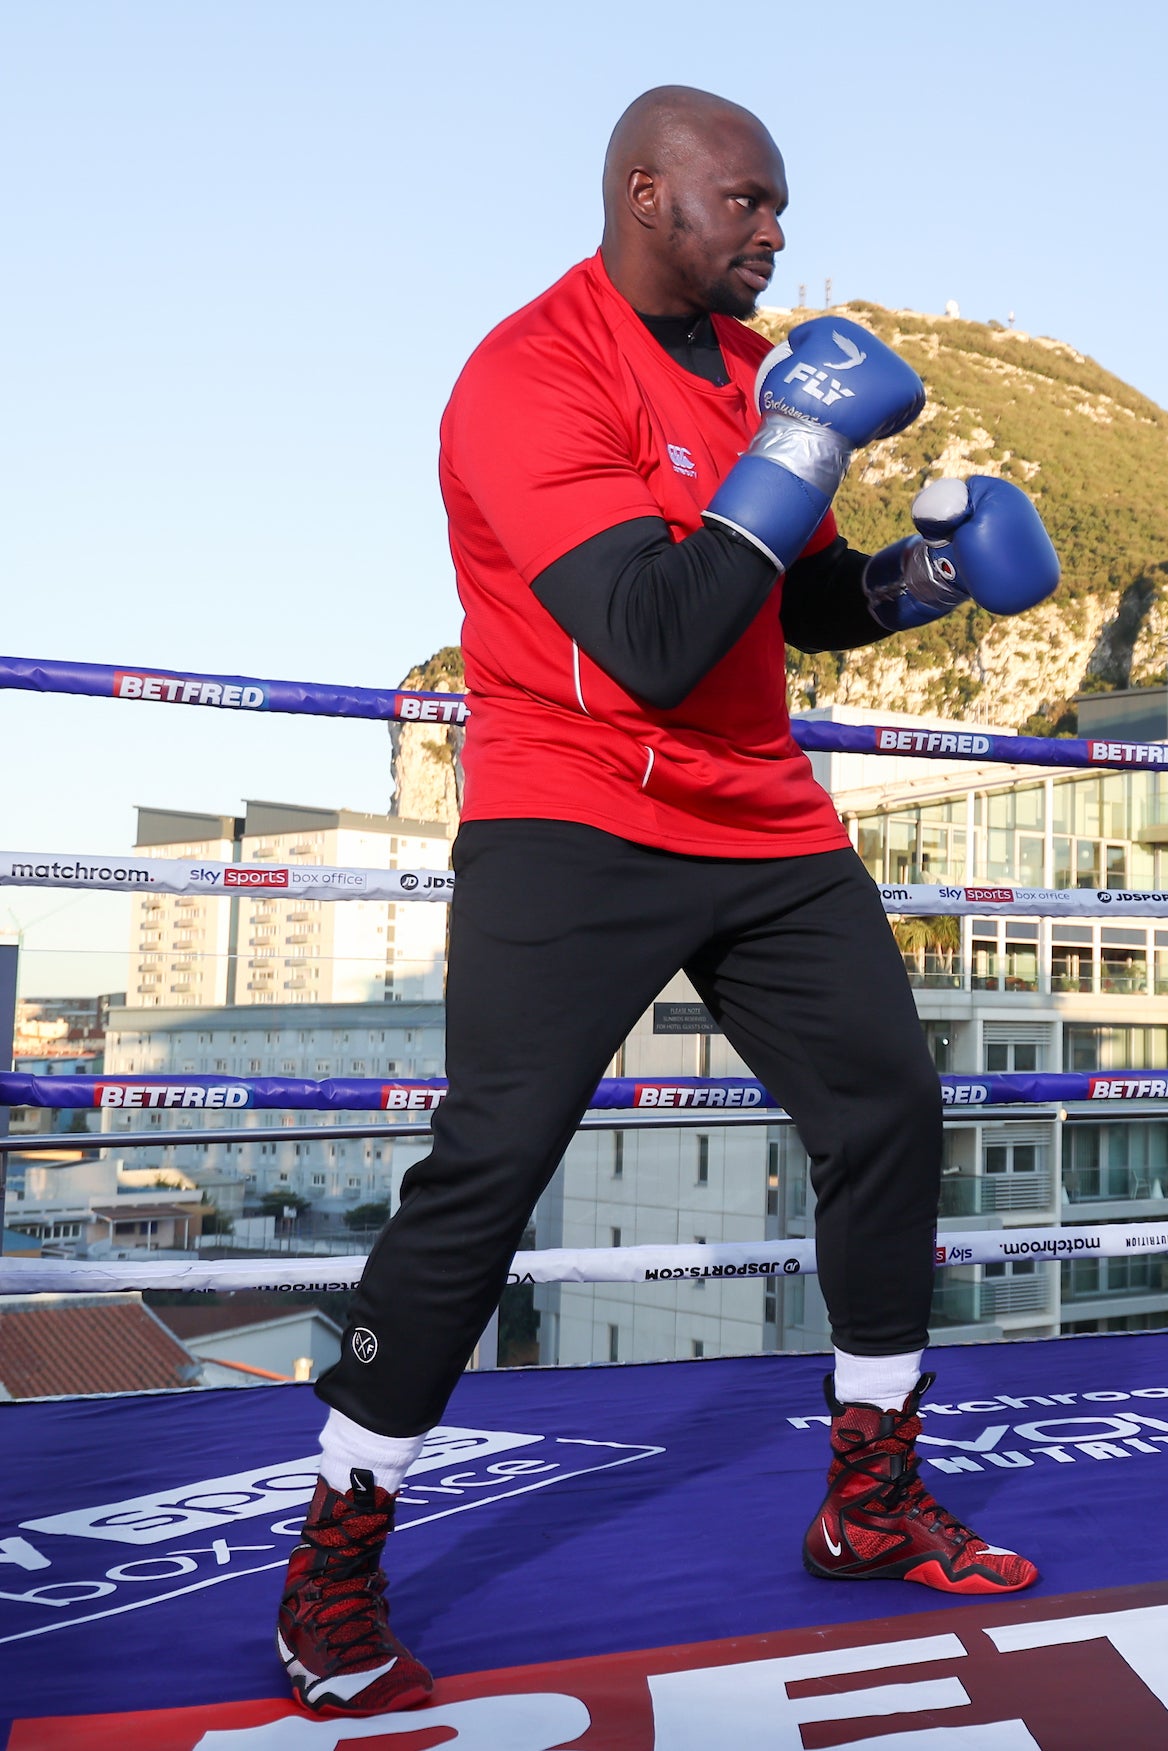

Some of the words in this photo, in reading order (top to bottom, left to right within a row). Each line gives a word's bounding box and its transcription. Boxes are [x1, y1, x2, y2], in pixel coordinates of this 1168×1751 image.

[783, 362, 856, 406] FLY
[118, 676, 265, 709] BETFRED
[400, 698, 472, 722] BETF
[879, 730, 990, 755] BETFRED
[11, 861, 155, 883] matchroom.
[189, 866, 221, 885] sky
[227, 868, 286, 886] sports
[291, 870, 319, 884] box
[321, 870, 364, 886] office
[939, 887, 962, 900] sky
[967, 888, 1013, 901] sports
[1015, 890, 1036, 900] box
[100, 1086, 248, 1109] BETFRED
[638, 1087, 762, 1107] BETFRED
[948, 1247, 972, 1262] sky
[999, 1237, 1101, 1257] matchroom.
[645, 1262, 780, 1281] JDSPORTS.COM
